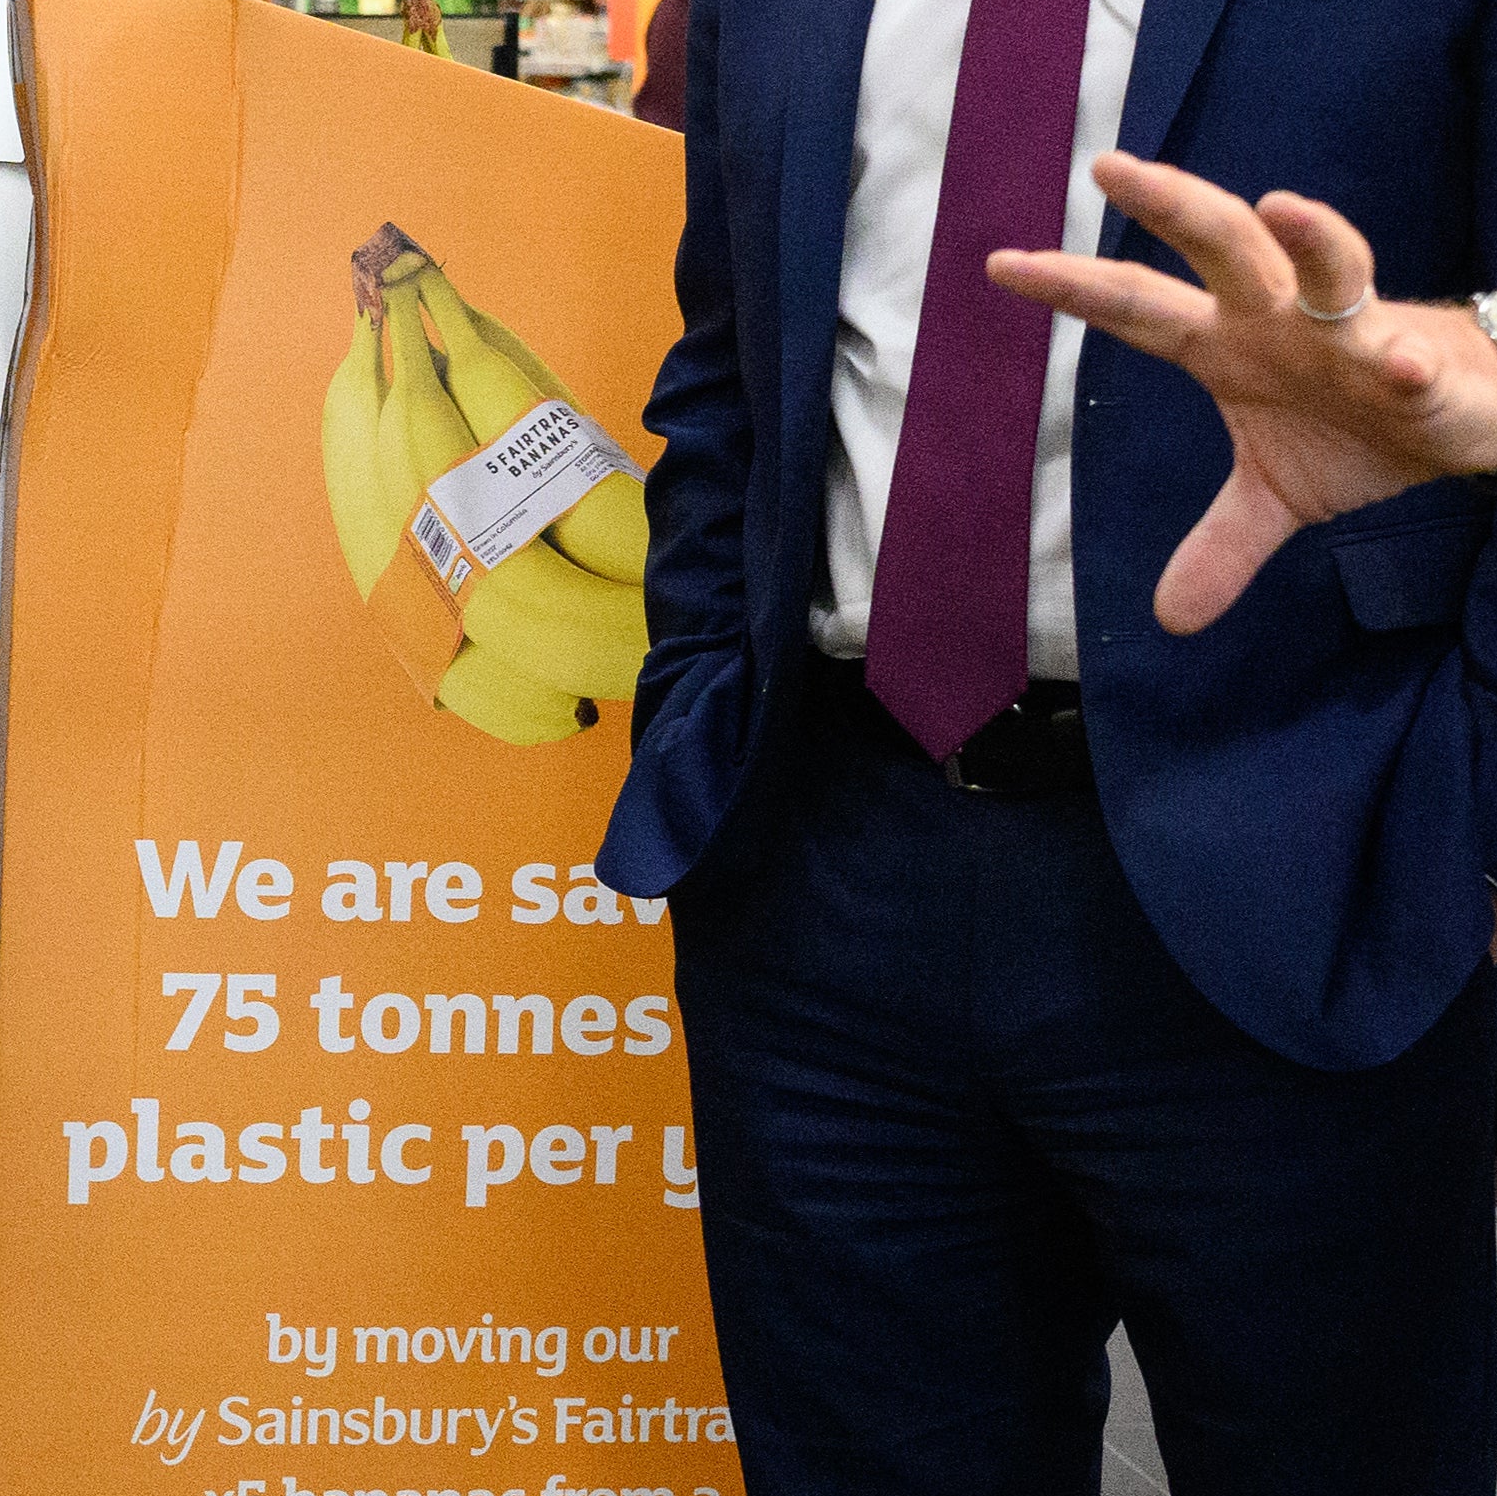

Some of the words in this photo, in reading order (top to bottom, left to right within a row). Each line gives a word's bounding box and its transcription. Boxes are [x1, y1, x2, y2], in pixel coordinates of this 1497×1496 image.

[486, 460, 499, 475] 5
[508, 417, 580, 478] BANANAS
[134, 839, 293, 921] We
[321, 860, 483, 924] are
[162, 973, 280, 1053] 75
[308, 975, 672, 1056] tonnes
[62, 1098, 432, 1205] plastic
[461, 1124, 633, 1208] per
[662, 1125, 700, 1209] y
[265, 1313, 338, 1378] by
[352, 1313, 568, 1377] moving
[583, 1326, 679, 1364] our
[131, 1389, 206, 1466] by
[217, 1395, 539, 1457] Sainsbury's
[553, 1393, 737, 1444] Fairtra
